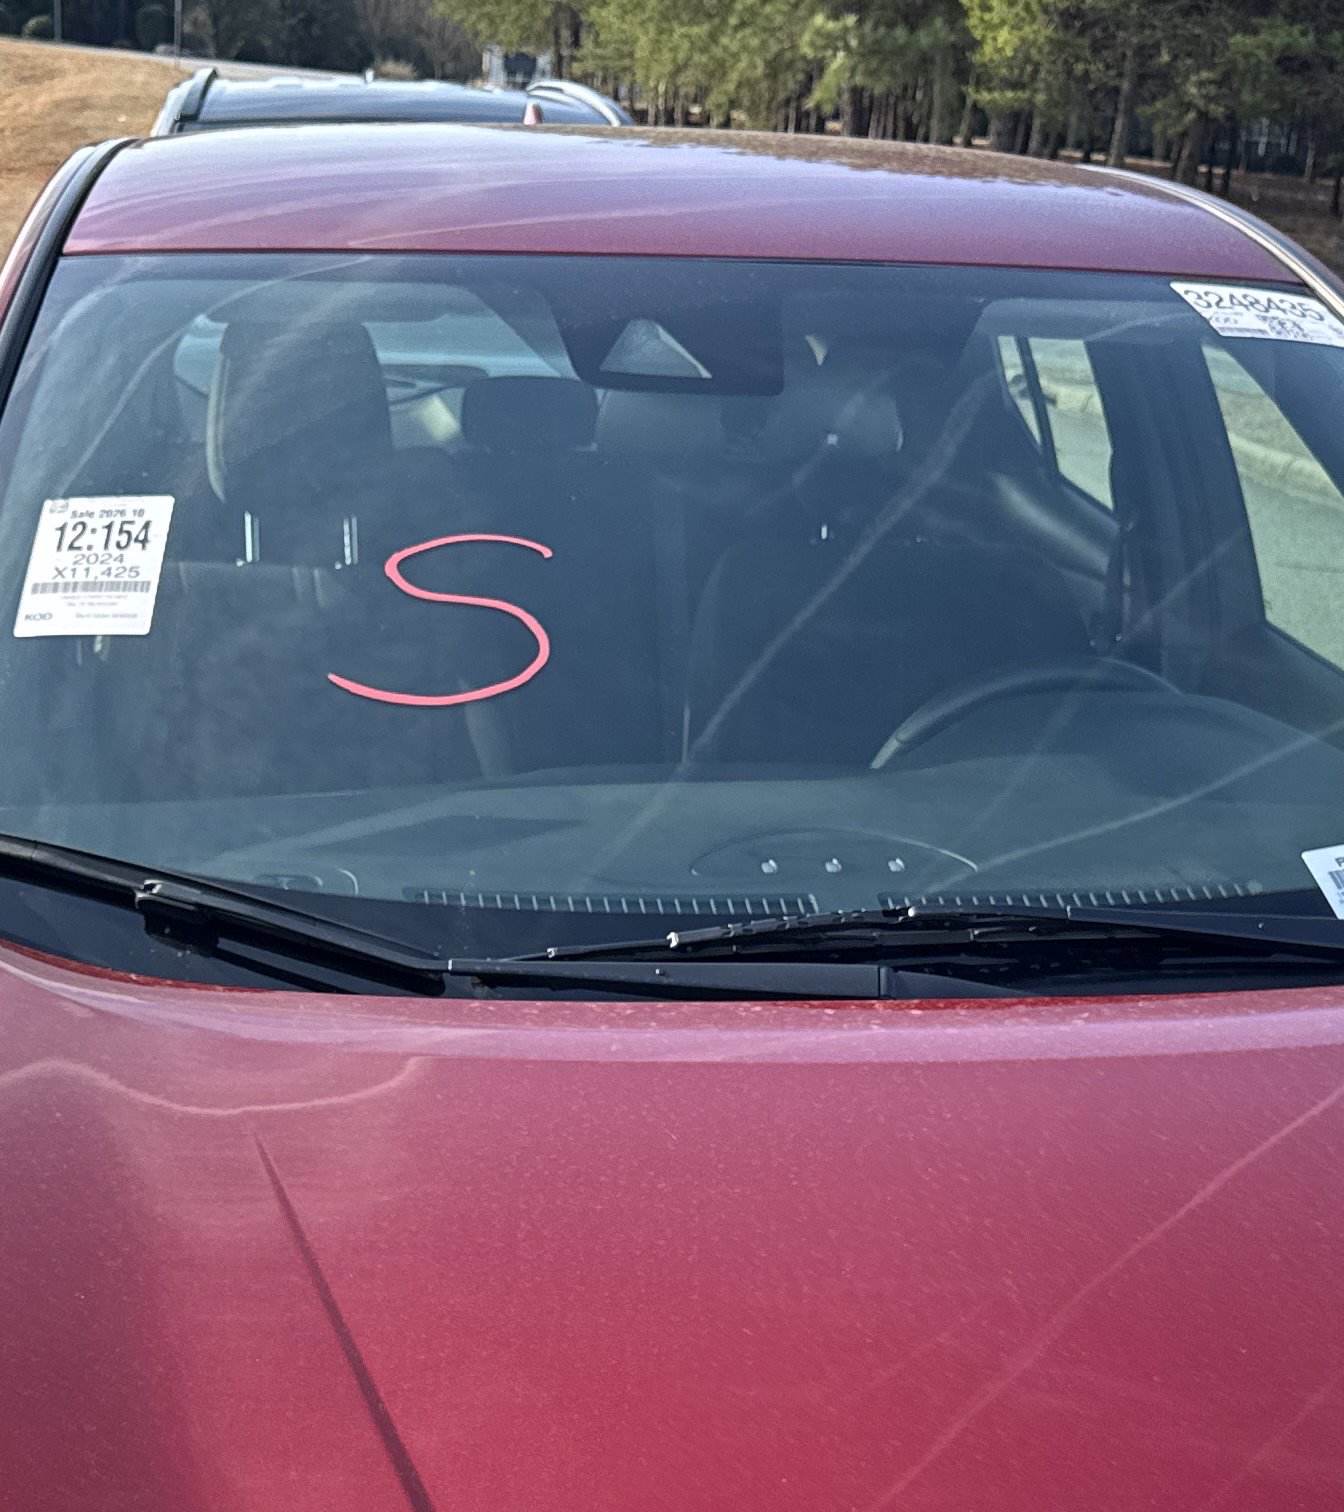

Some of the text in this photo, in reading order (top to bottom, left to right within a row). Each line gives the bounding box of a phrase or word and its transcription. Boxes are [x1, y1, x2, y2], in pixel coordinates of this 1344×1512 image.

[1183, 289, 1325, 322] 3248435
[70, 509, 95, 519] Sale
[55, 520, 153, 552] 12:154
[72, 553, 125, 566] 2024
[52, 566, 141, 581] X11,425
[327, 533, 553, 706] S
